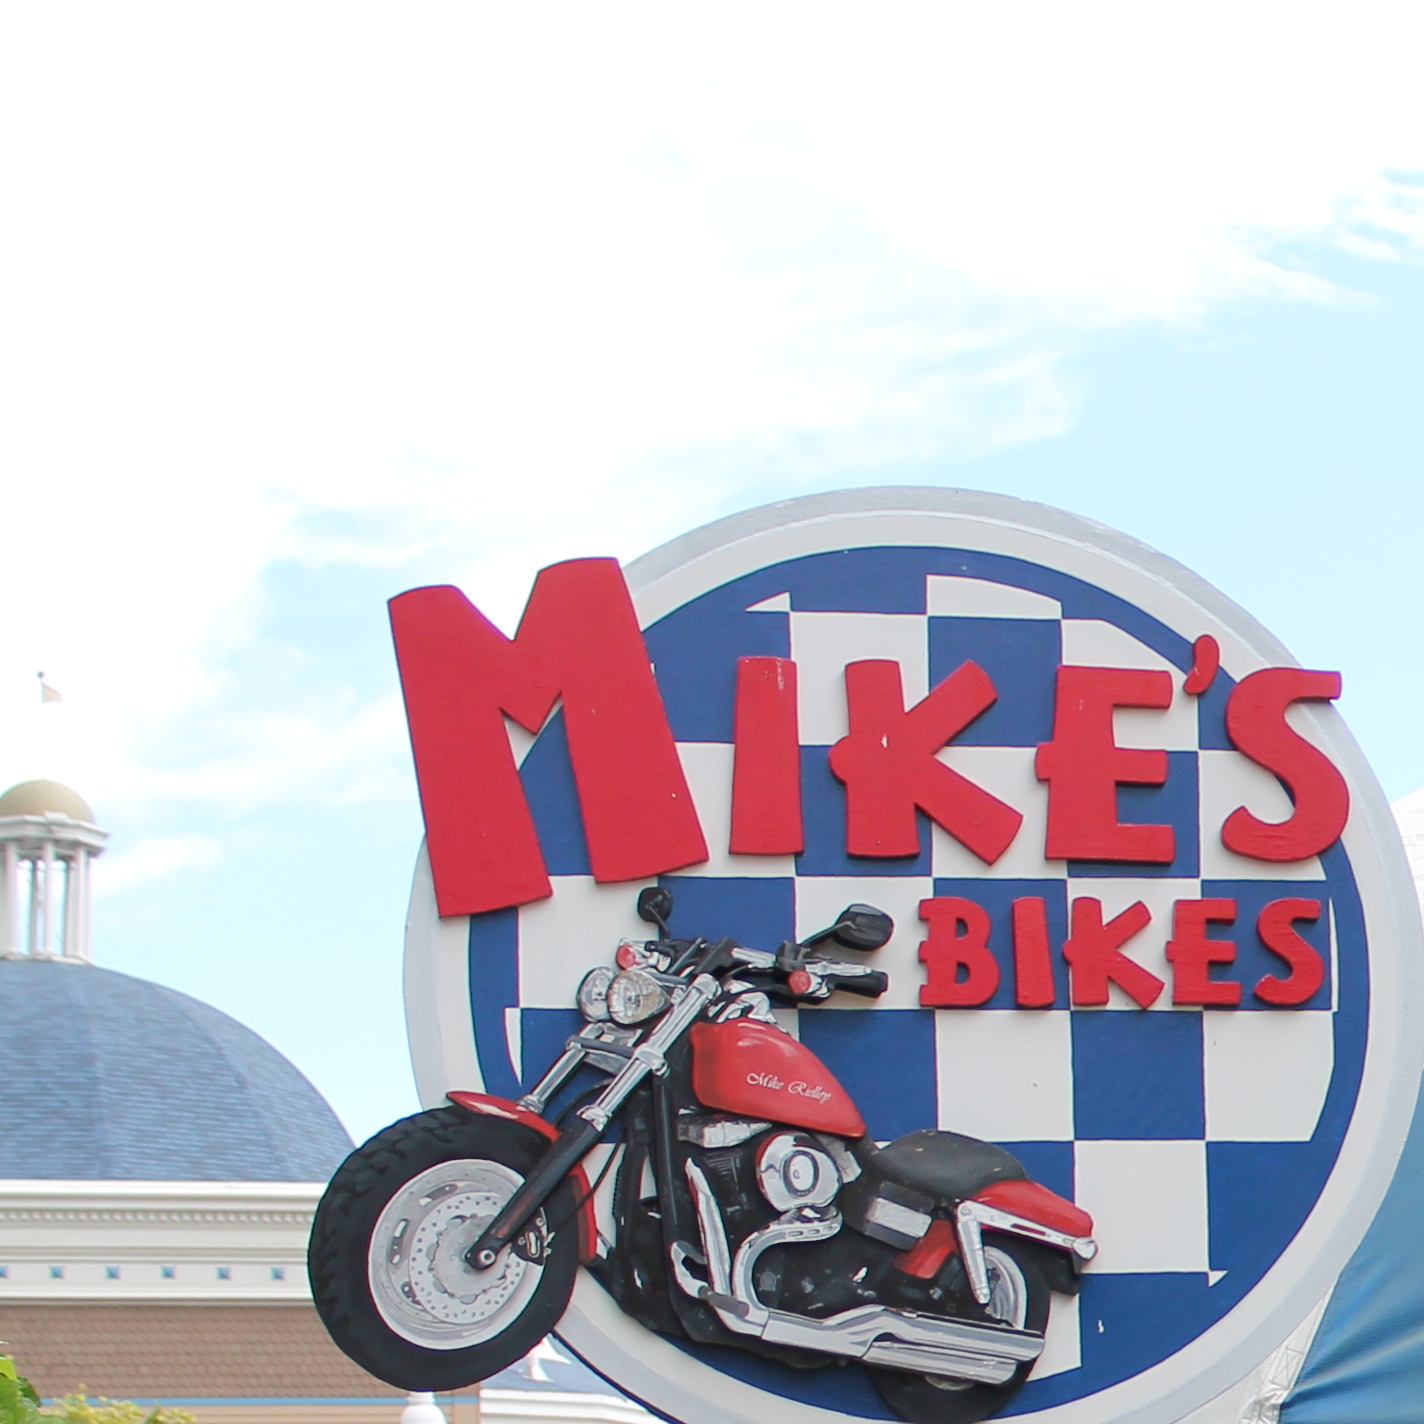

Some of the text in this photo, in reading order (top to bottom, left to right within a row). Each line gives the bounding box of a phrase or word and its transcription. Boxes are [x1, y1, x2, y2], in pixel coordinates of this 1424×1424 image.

[387, 557, 1350, 918] MIKE'S
[917, 894, 1325, 1010] BIKES
[747, 1072, 784, 1090] Mike
